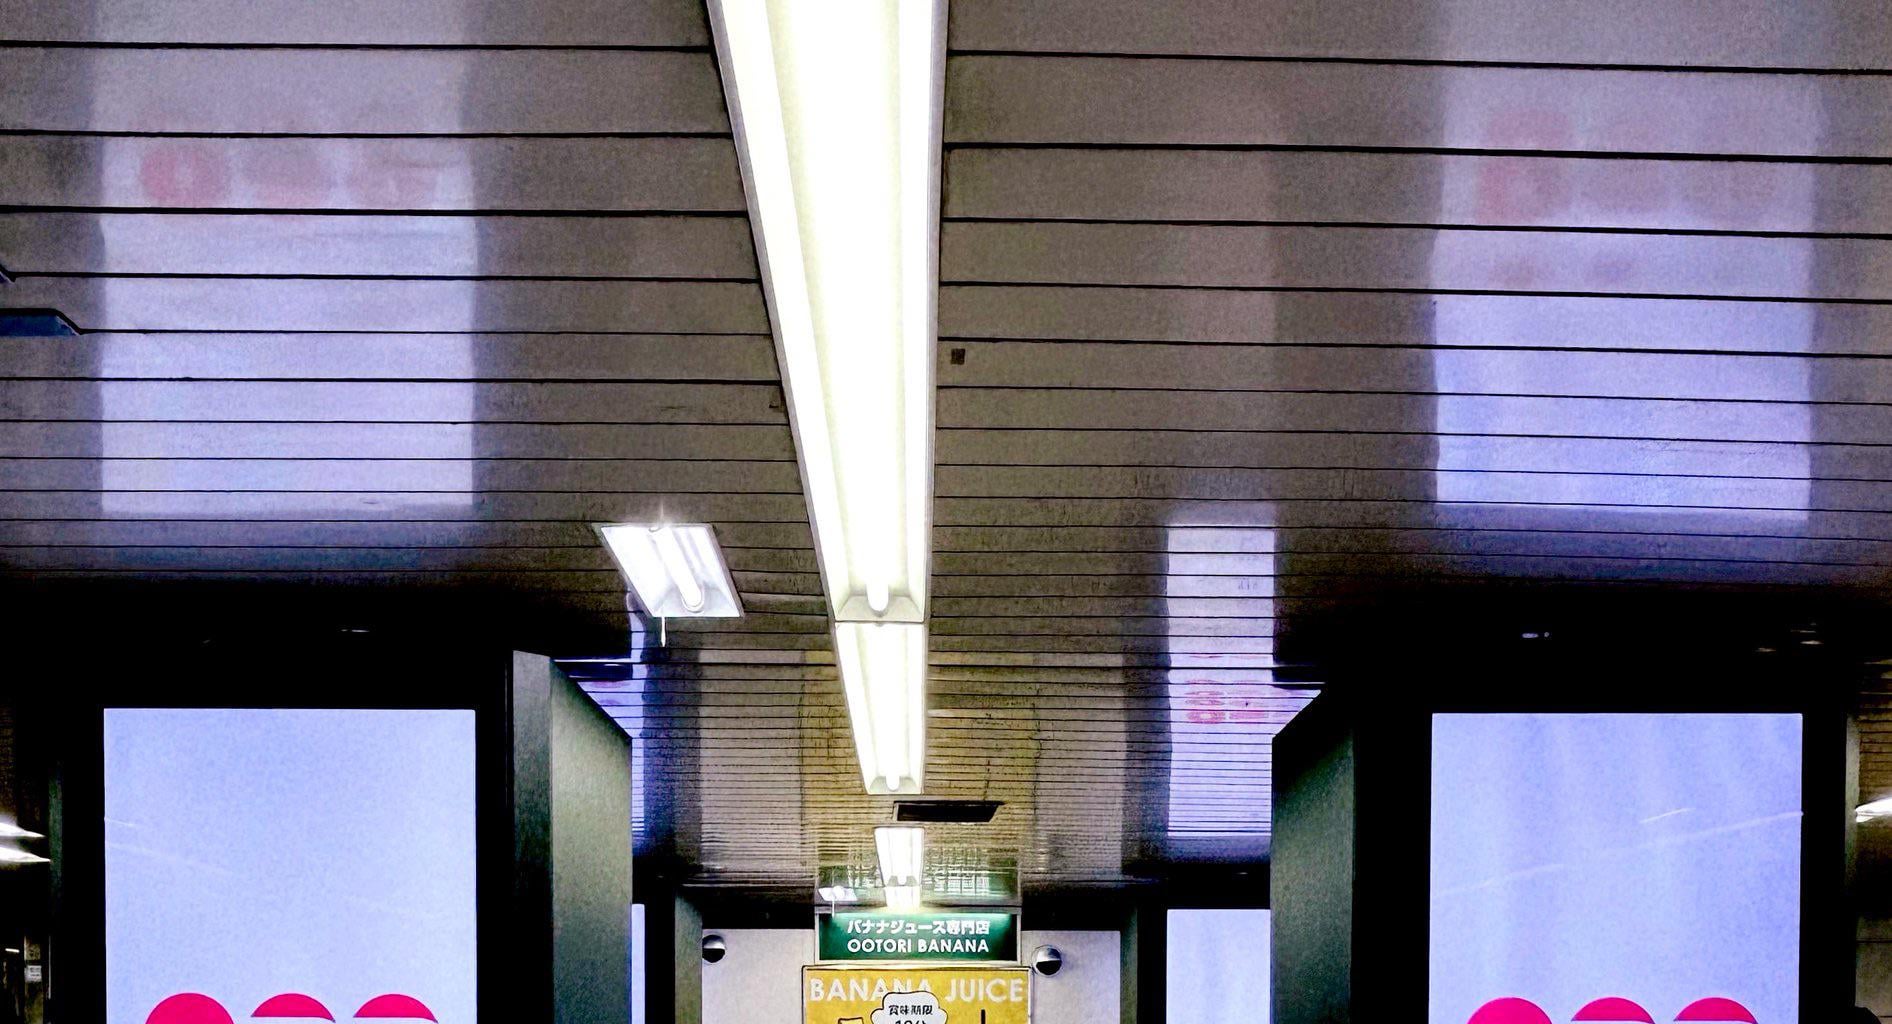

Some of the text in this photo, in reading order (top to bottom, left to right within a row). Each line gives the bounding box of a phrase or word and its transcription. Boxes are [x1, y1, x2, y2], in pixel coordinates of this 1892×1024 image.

[847, 919, 990, 935] バナナジュース専門店
[847, 938, 989, 953] OOTORI BANANA
[945, 978, 1024, 1002] JUICE
